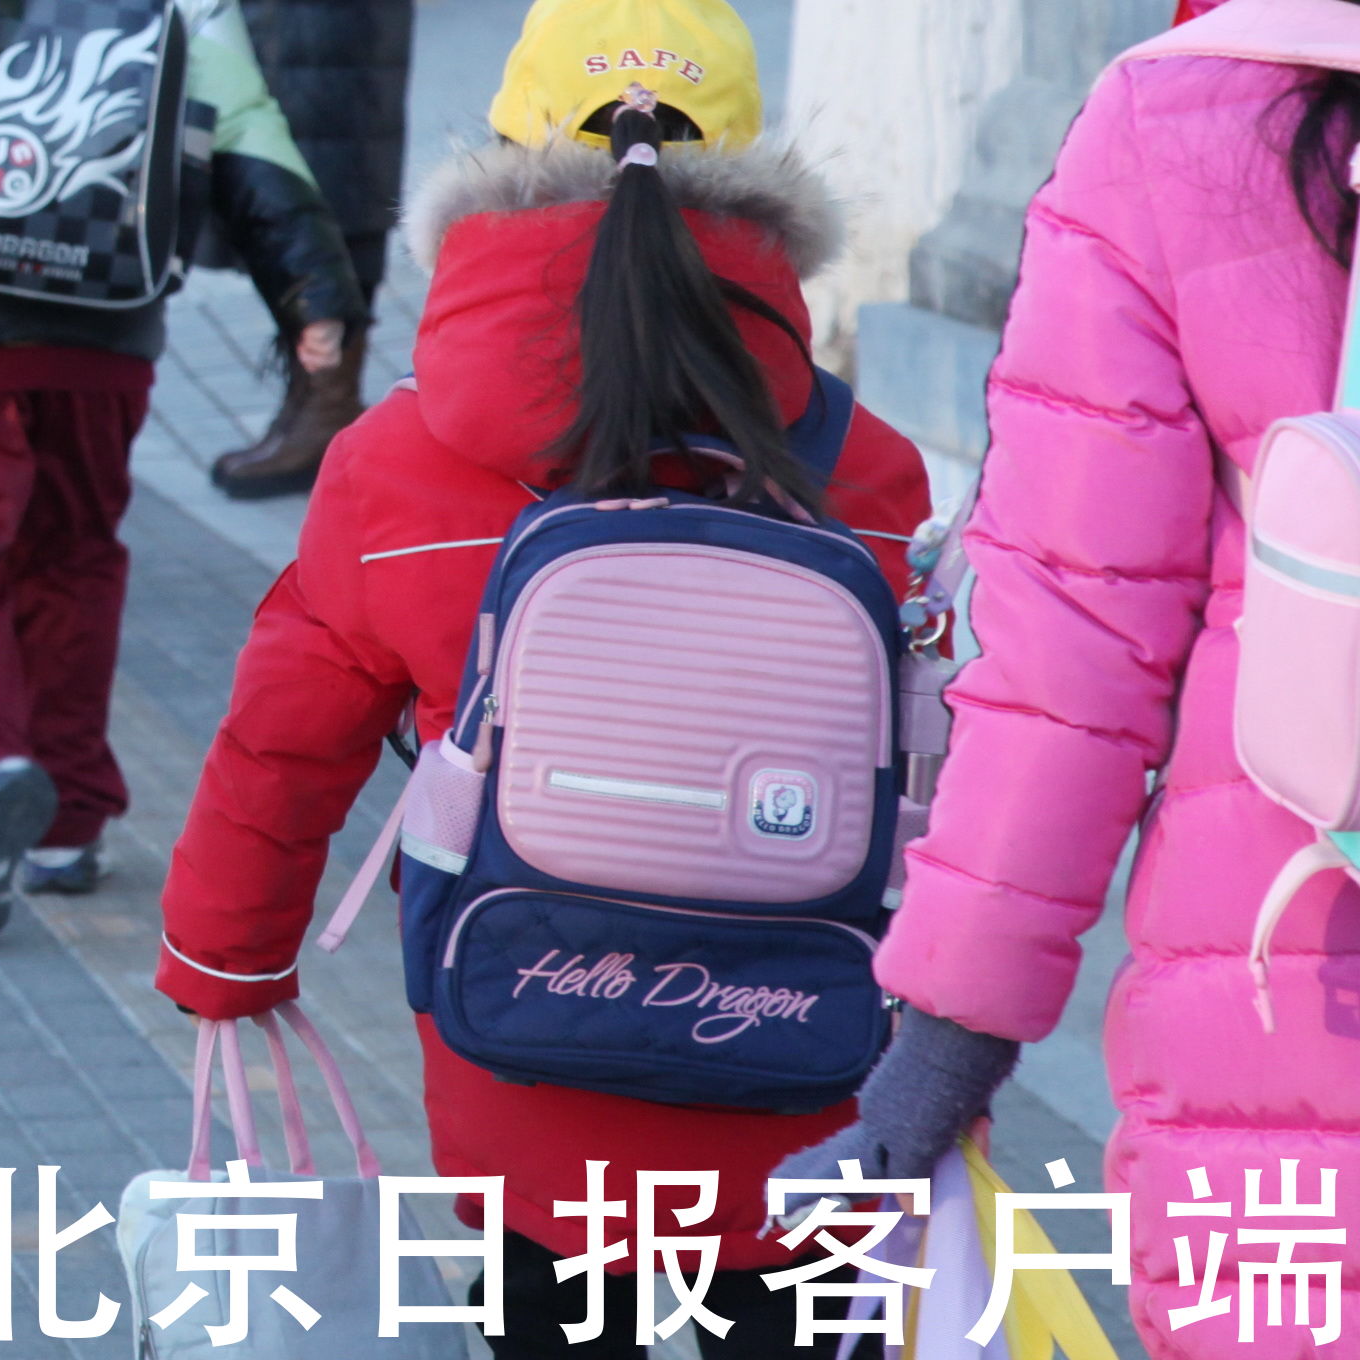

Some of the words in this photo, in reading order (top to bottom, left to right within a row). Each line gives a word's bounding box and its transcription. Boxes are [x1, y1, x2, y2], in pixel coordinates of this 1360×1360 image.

[585, 48, 704, 84] SAFE
[513, 949, 636, 999] Hello
[642, 962, 818, 1044] Dragon
